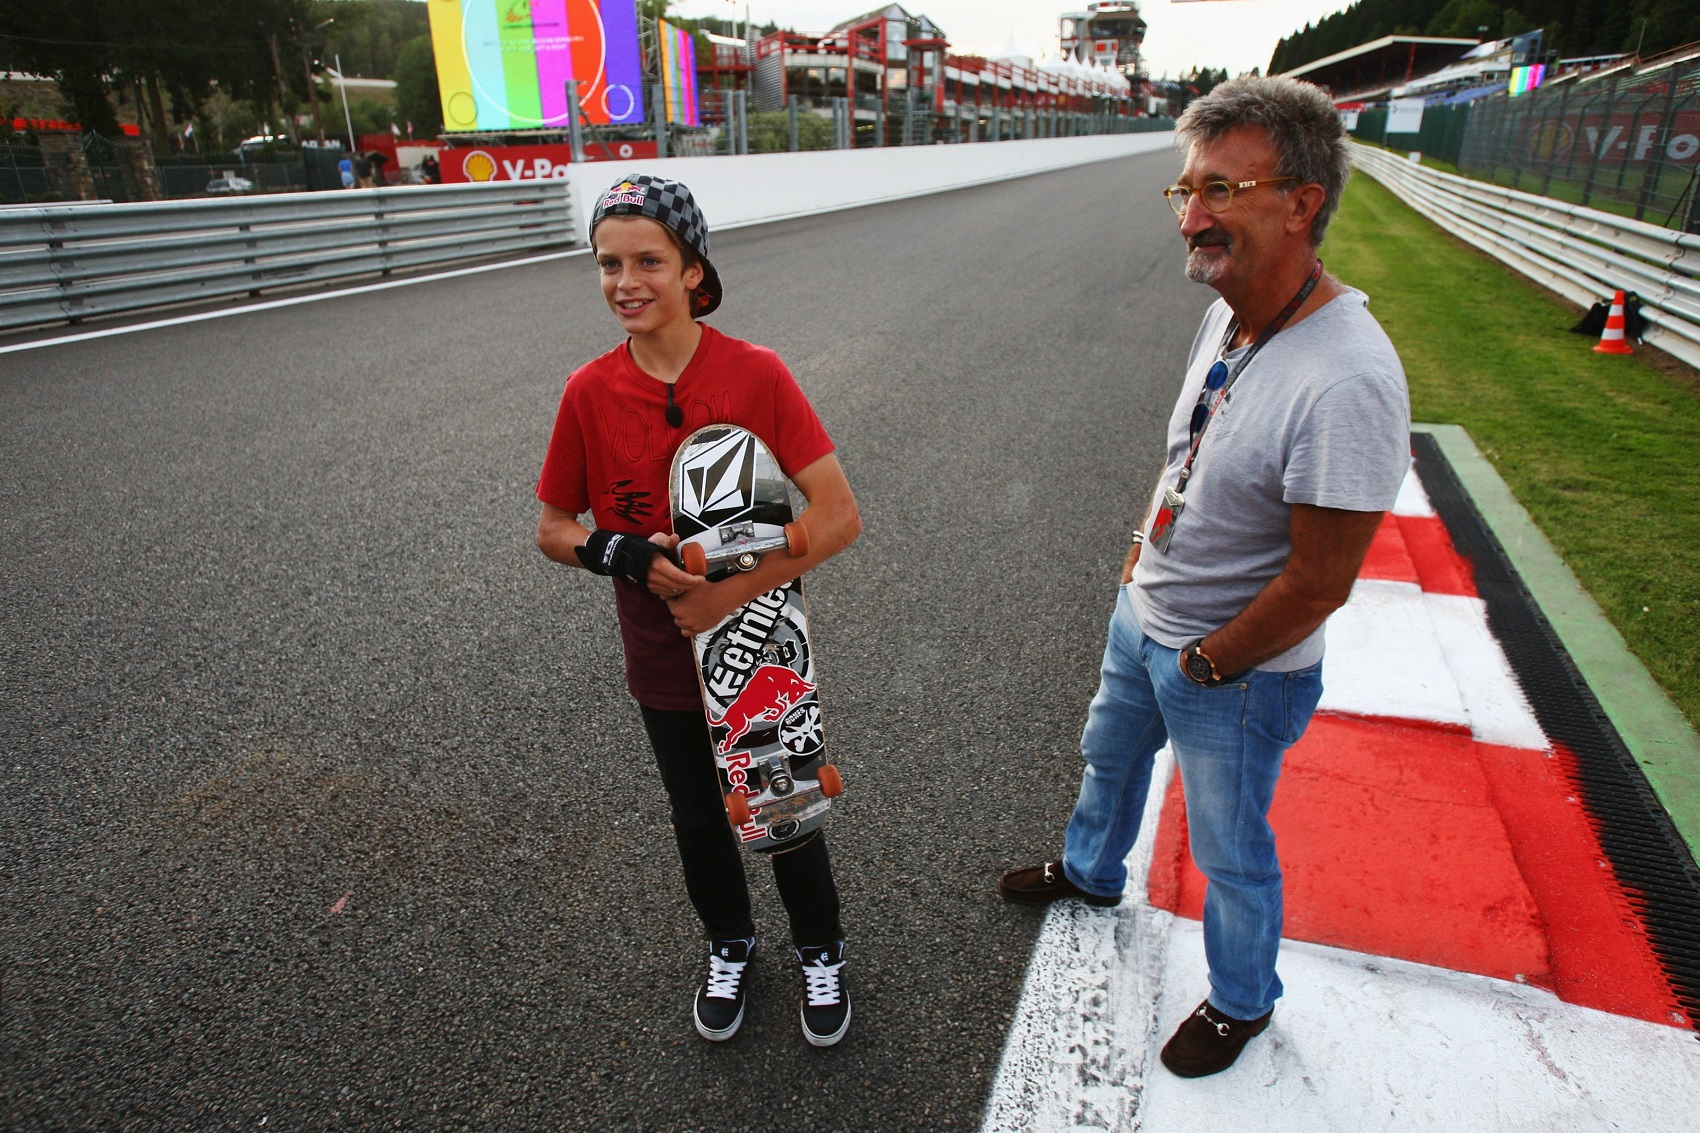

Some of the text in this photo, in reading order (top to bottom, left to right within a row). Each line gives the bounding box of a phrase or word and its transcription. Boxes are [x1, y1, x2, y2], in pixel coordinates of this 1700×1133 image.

[603, 194, 645, 209] Red Bull
[784, 706, 806, 726] BONES
